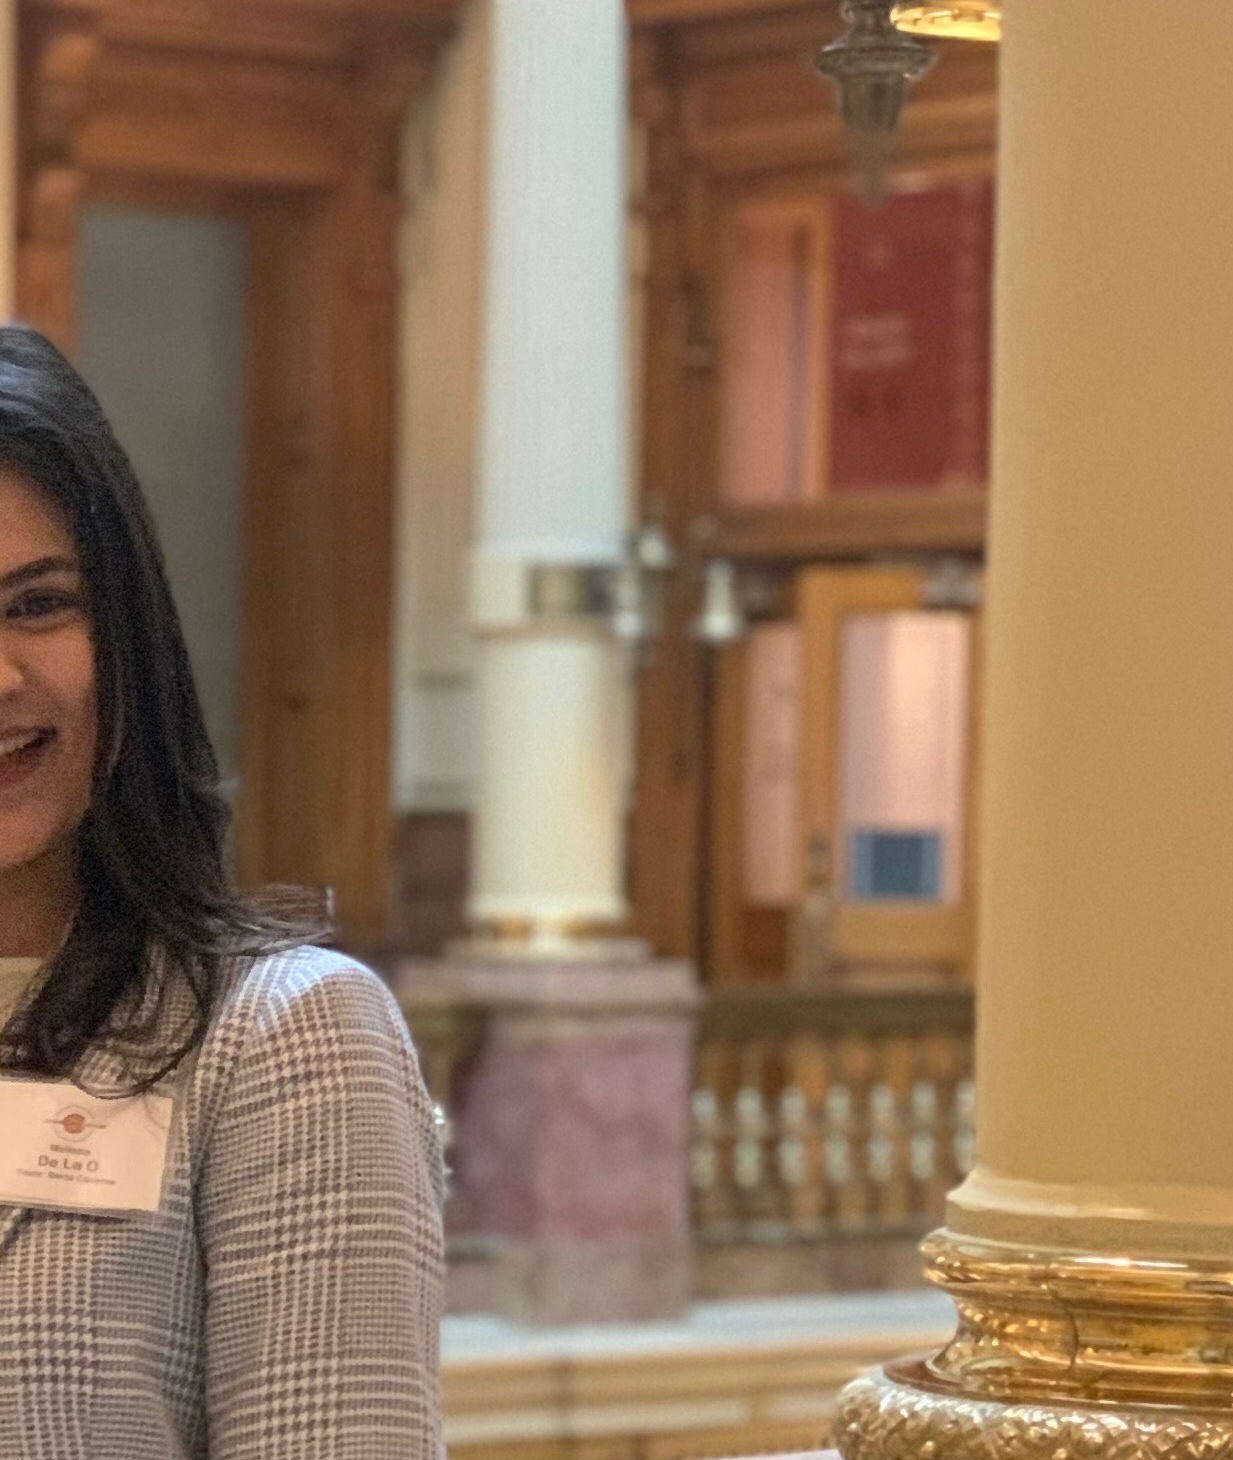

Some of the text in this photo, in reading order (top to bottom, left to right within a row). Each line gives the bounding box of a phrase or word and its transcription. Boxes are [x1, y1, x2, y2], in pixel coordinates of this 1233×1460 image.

[38, 1155, 99, 1172] De La O
